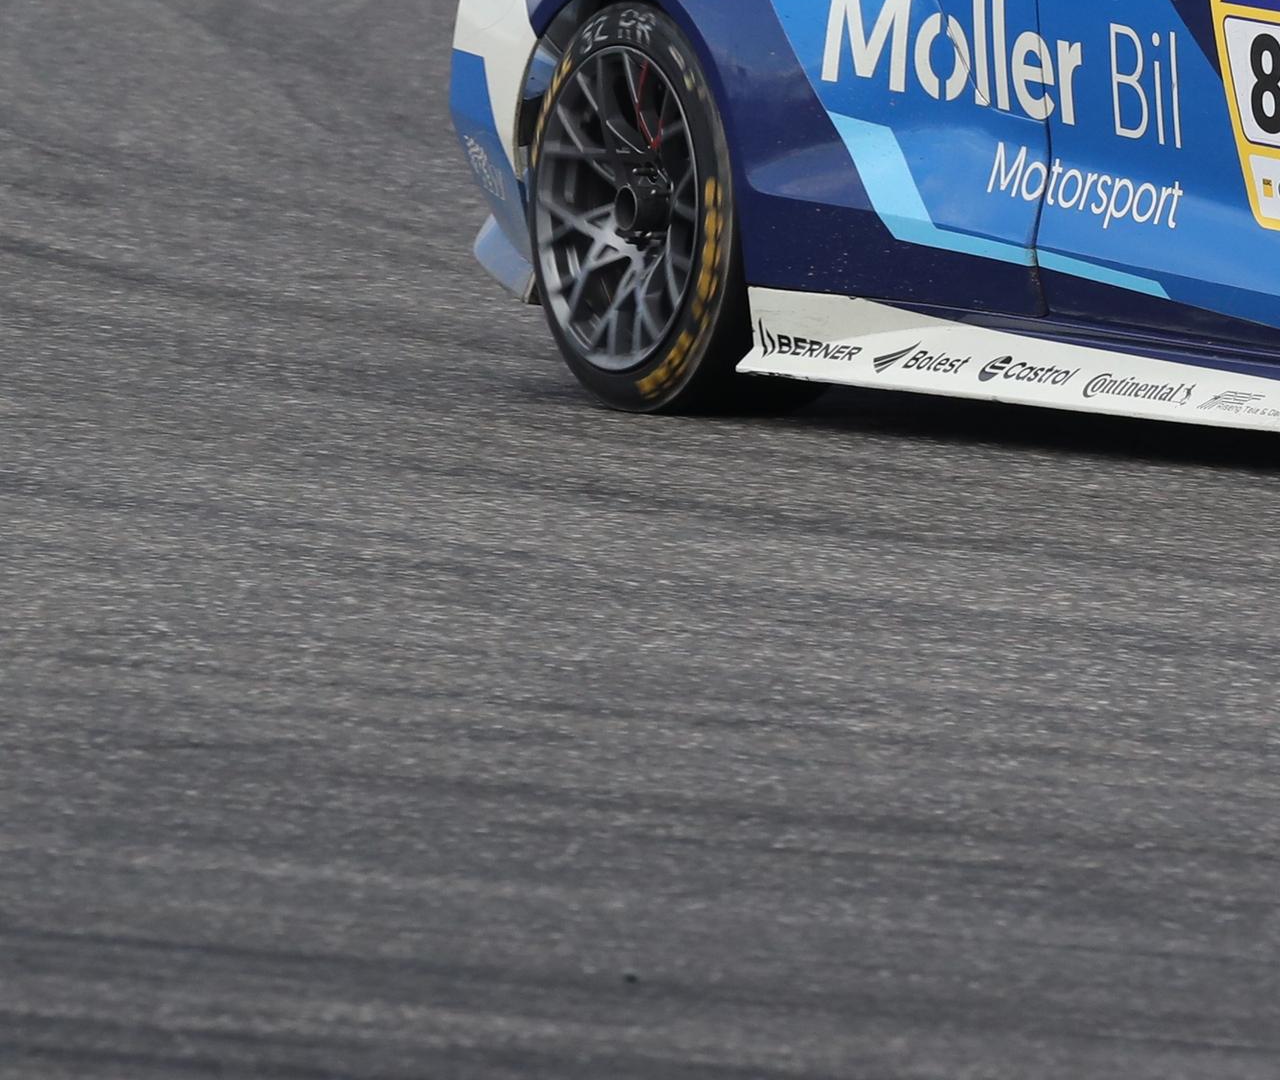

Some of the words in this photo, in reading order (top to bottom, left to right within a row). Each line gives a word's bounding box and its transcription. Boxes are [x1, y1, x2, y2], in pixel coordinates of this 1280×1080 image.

[1109, 22, 1182, 149] Bil
[986, 141, 1184, 229] Motorsport
[777, 334, 862, 362] BERNER
[902, 350, 972, 374] Bolest
[1004, 361, 1081, 387] Castrol
[1083, 373, 1185, 404] Continental
